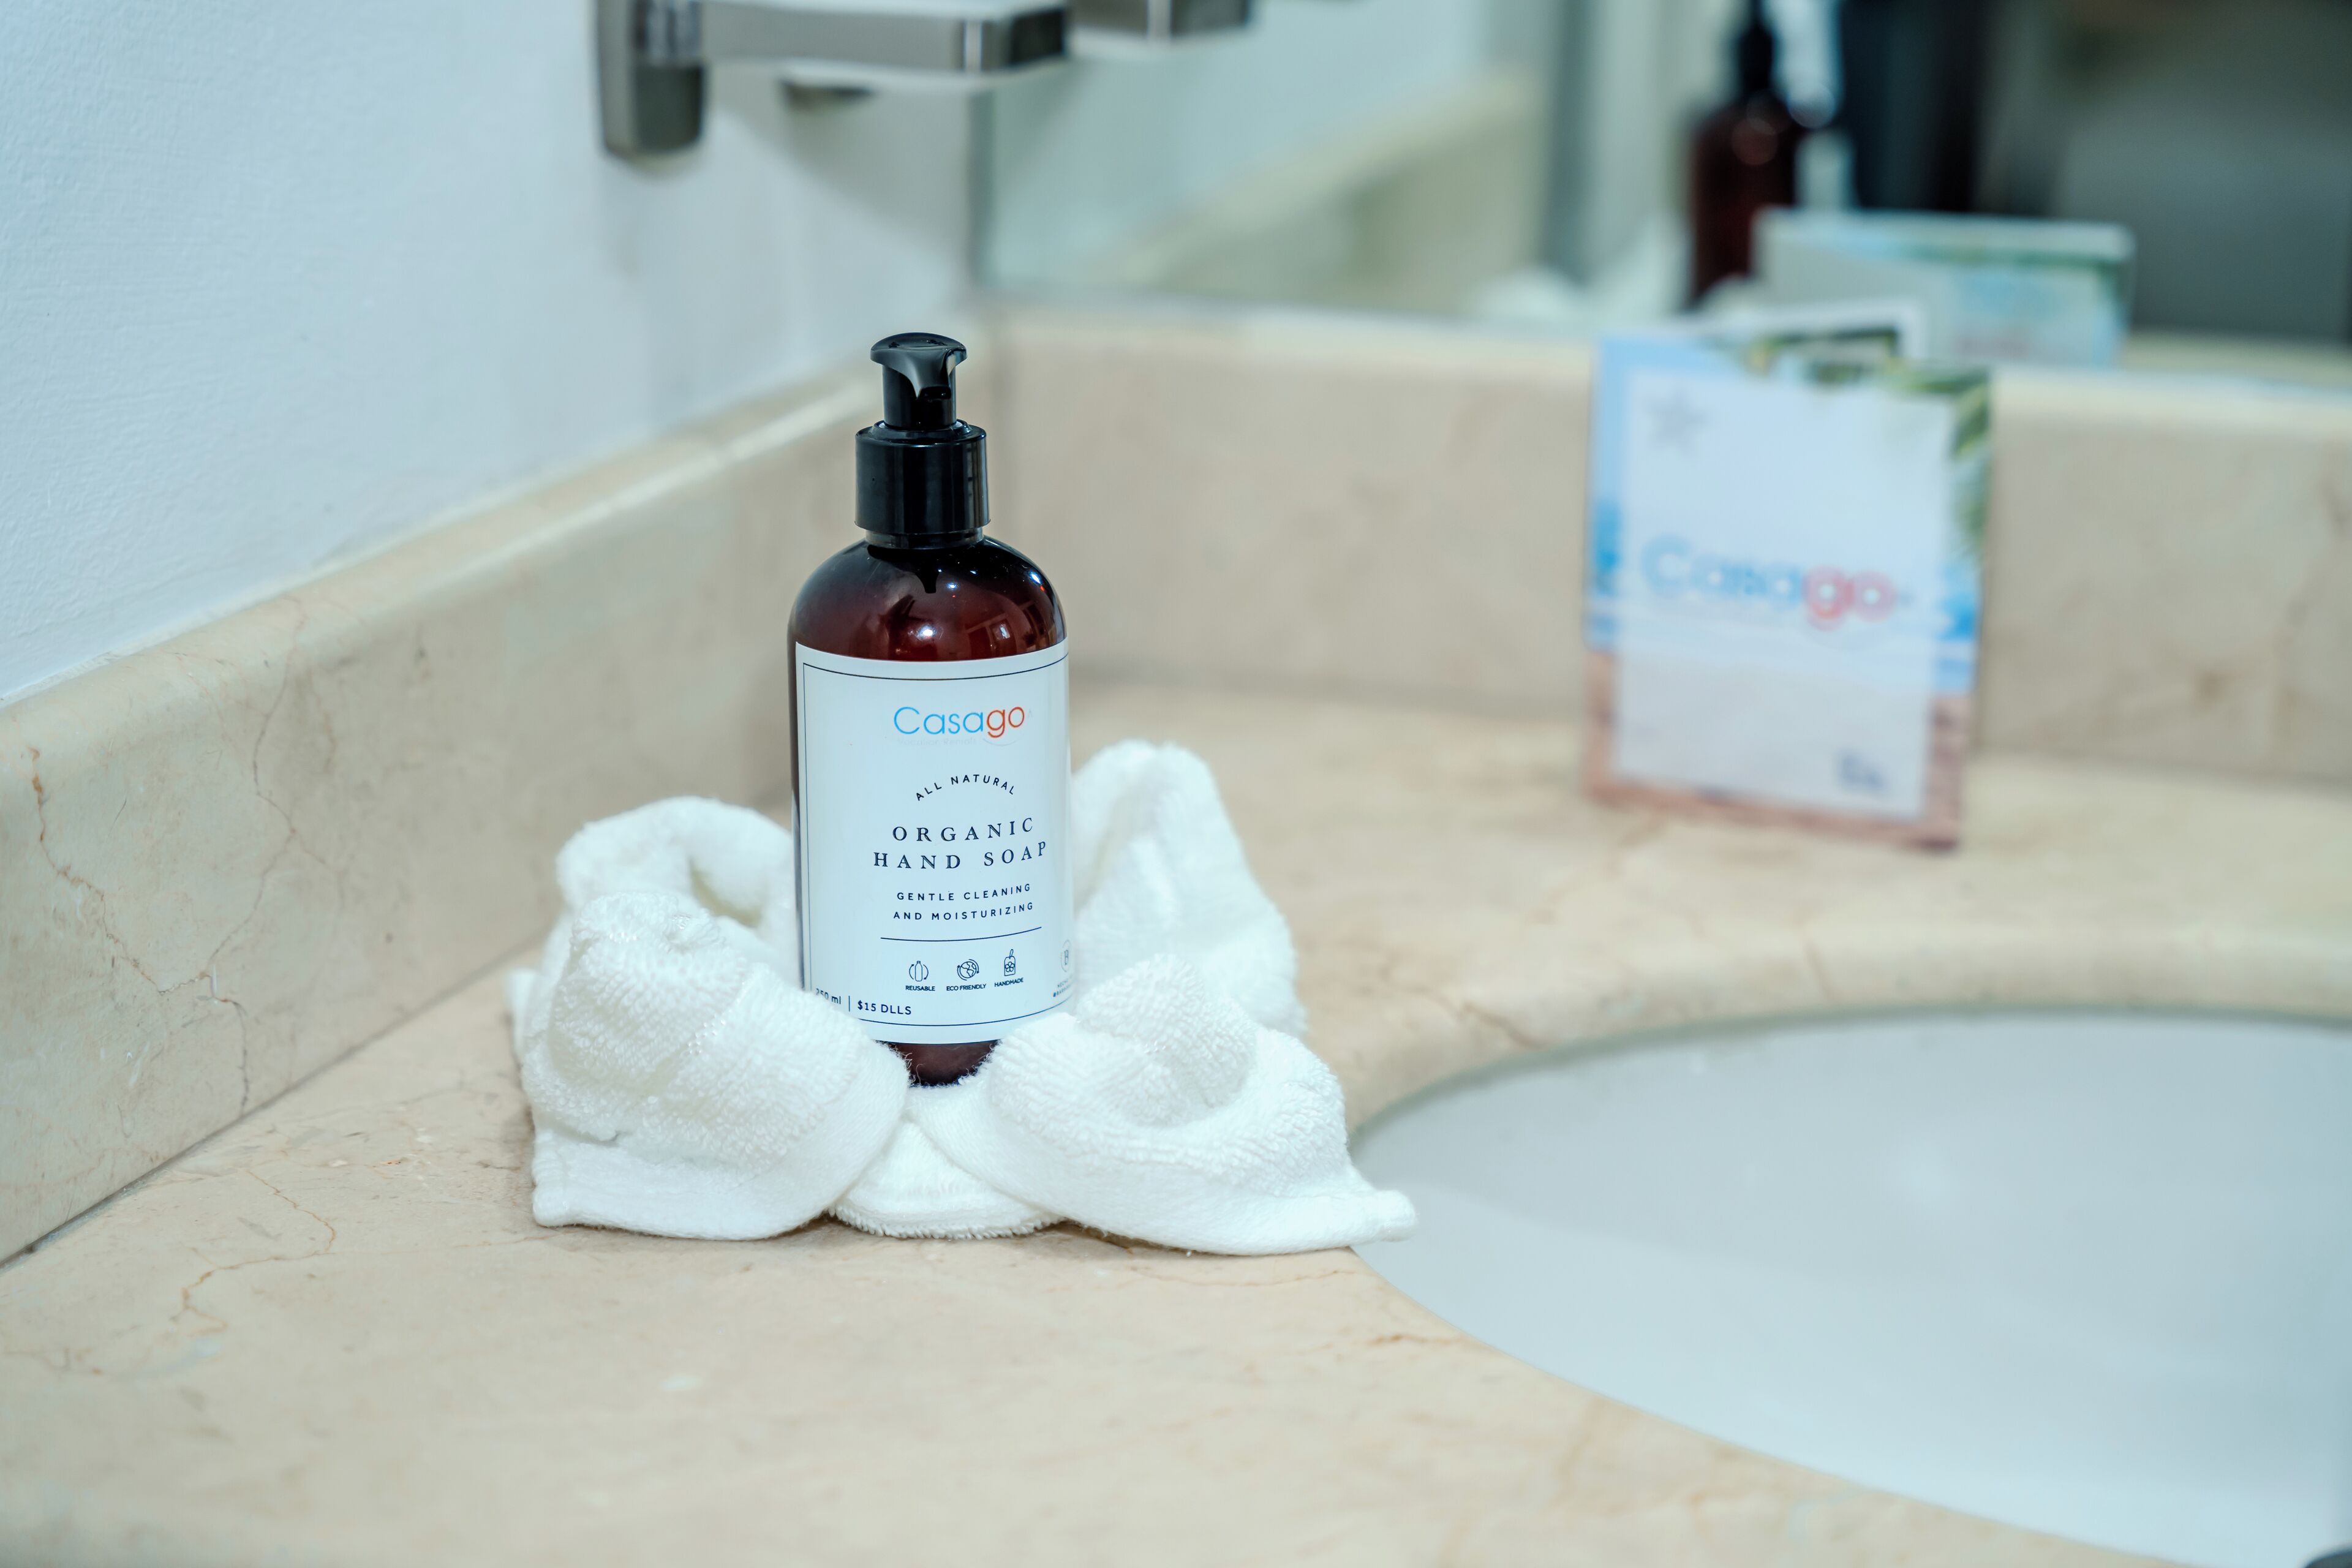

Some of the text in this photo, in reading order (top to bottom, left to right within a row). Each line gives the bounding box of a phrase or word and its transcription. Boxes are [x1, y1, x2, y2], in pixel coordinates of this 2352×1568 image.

[894, 707, 1024, 738] Casago
[916, 774, 1014, 801] ALL NATURAL
[892, 818, 1033, 842] ORGANIC
[873, 842, 1046, 869] HAND SOAP
[897, 884, 1031, 901] GENTLE CLEANING
[894, 903, 1033, 920] AND MOISTURIZING
[994, 978, 1023, 987] HANDMADE
[831, 996, 841, 1005] ml
[858, 1000, 876, 1012] $15
[881, 1004, 911, 1015] DLLS
